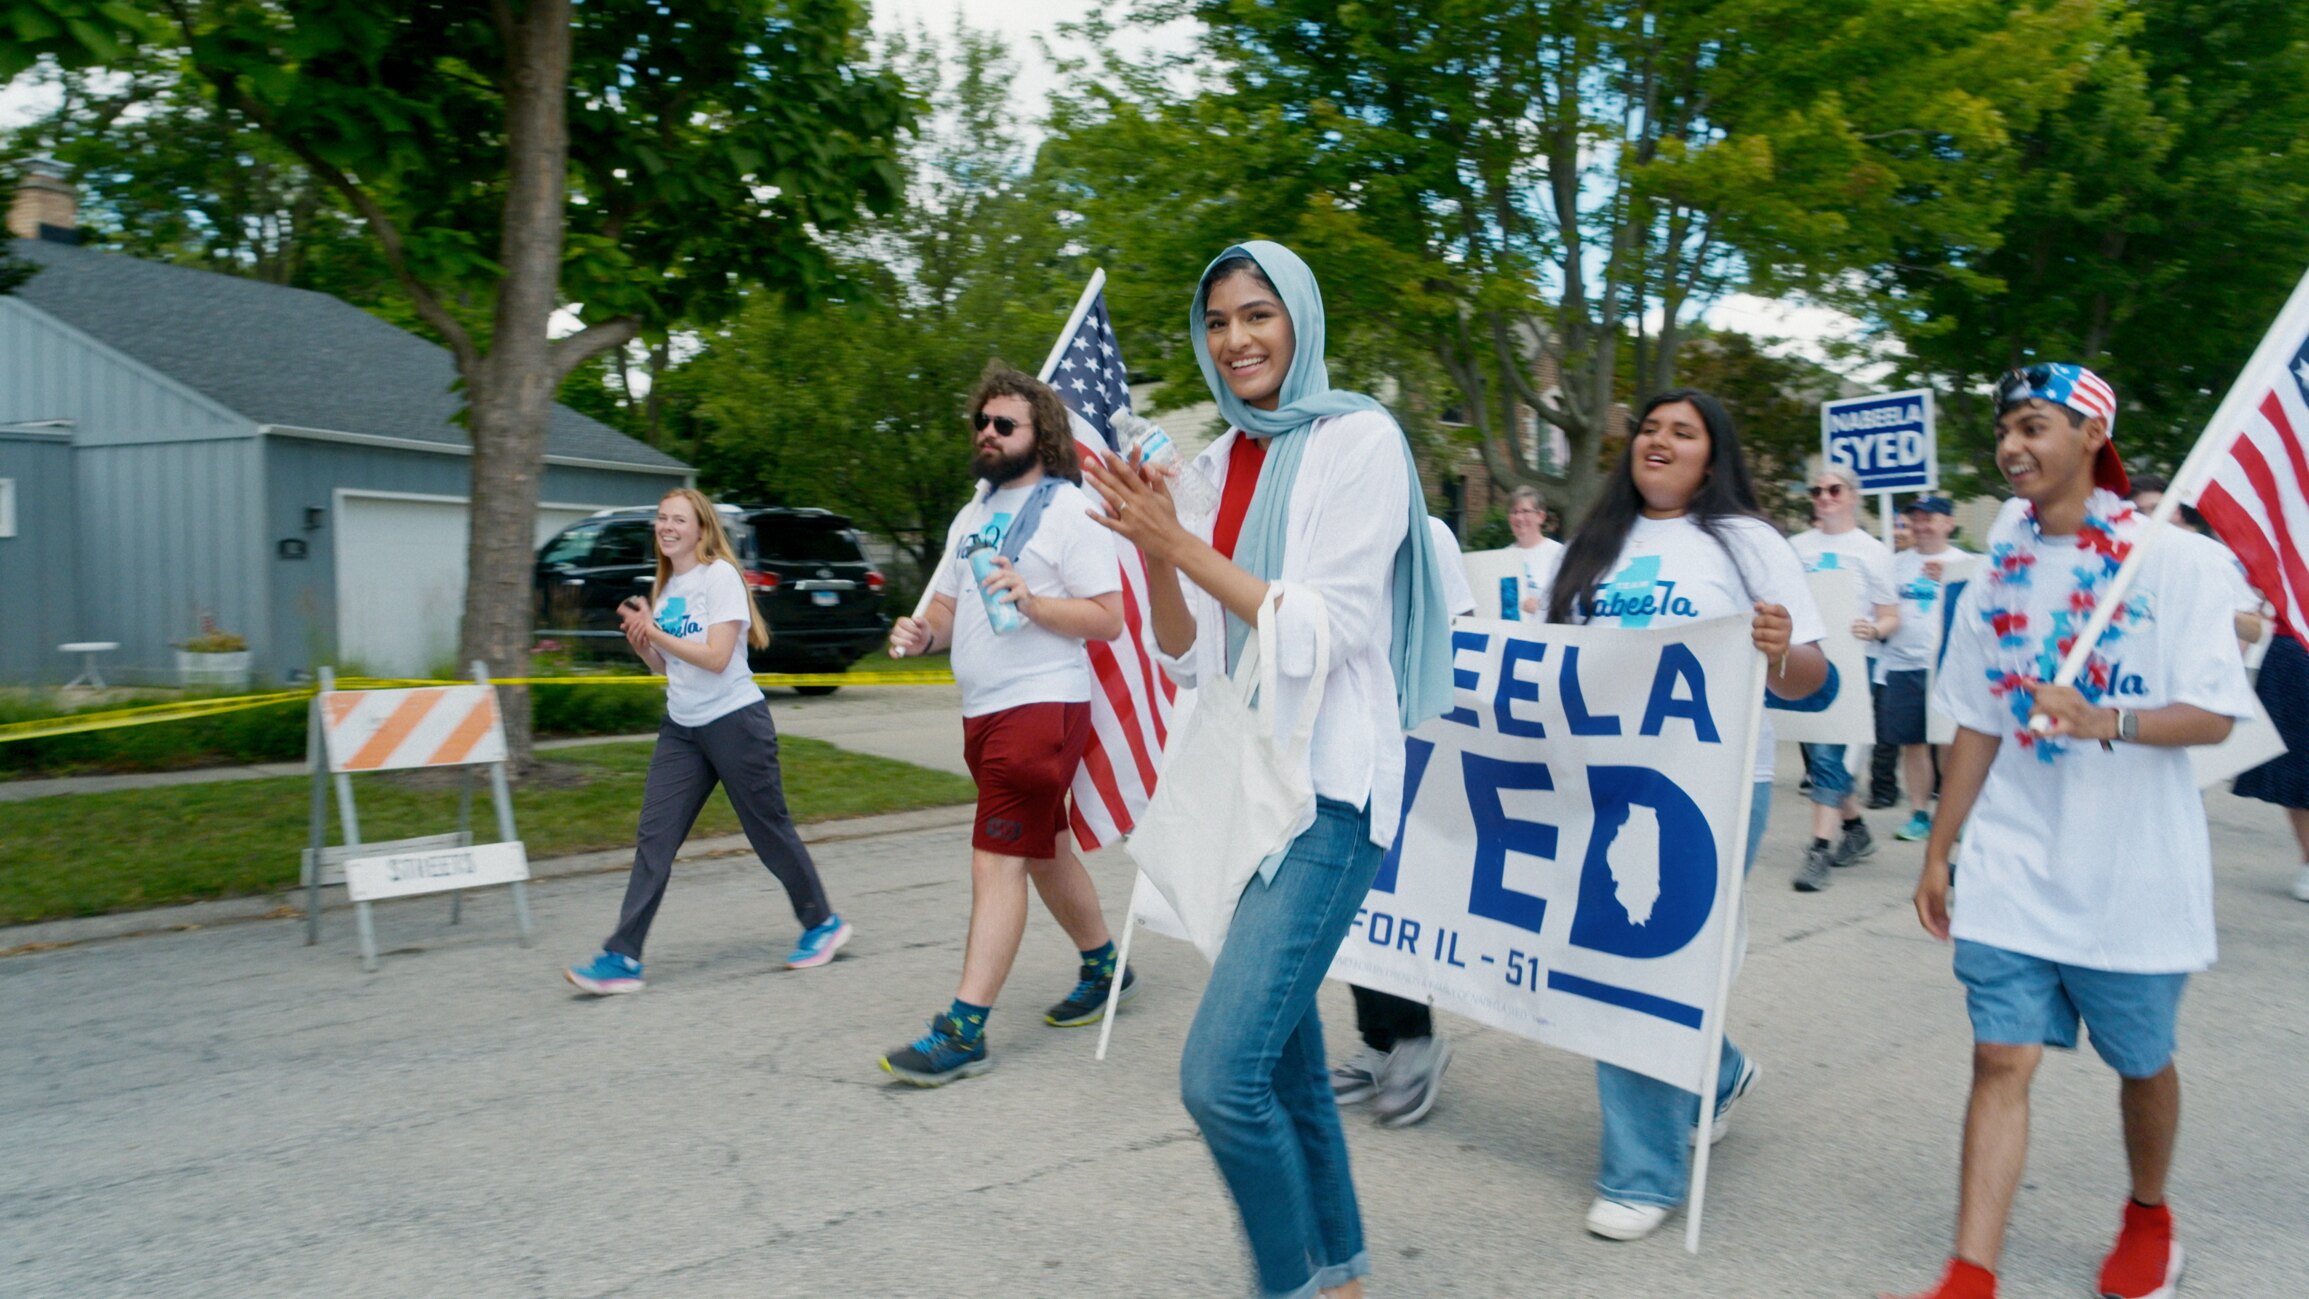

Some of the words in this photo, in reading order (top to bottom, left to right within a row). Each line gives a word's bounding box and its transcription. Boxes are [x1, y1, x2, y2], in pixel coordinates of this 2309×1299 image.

[1829, 404, 1923, 432] NABEELA
[1830, 430, 1924, 470] SYED
[1440, 631, 1722, 744] EELA
[1345, 907, 1420, 955] FOR
[1434, 929, 1466, 968] IL
[1505, 950, 1539, 992] 51
